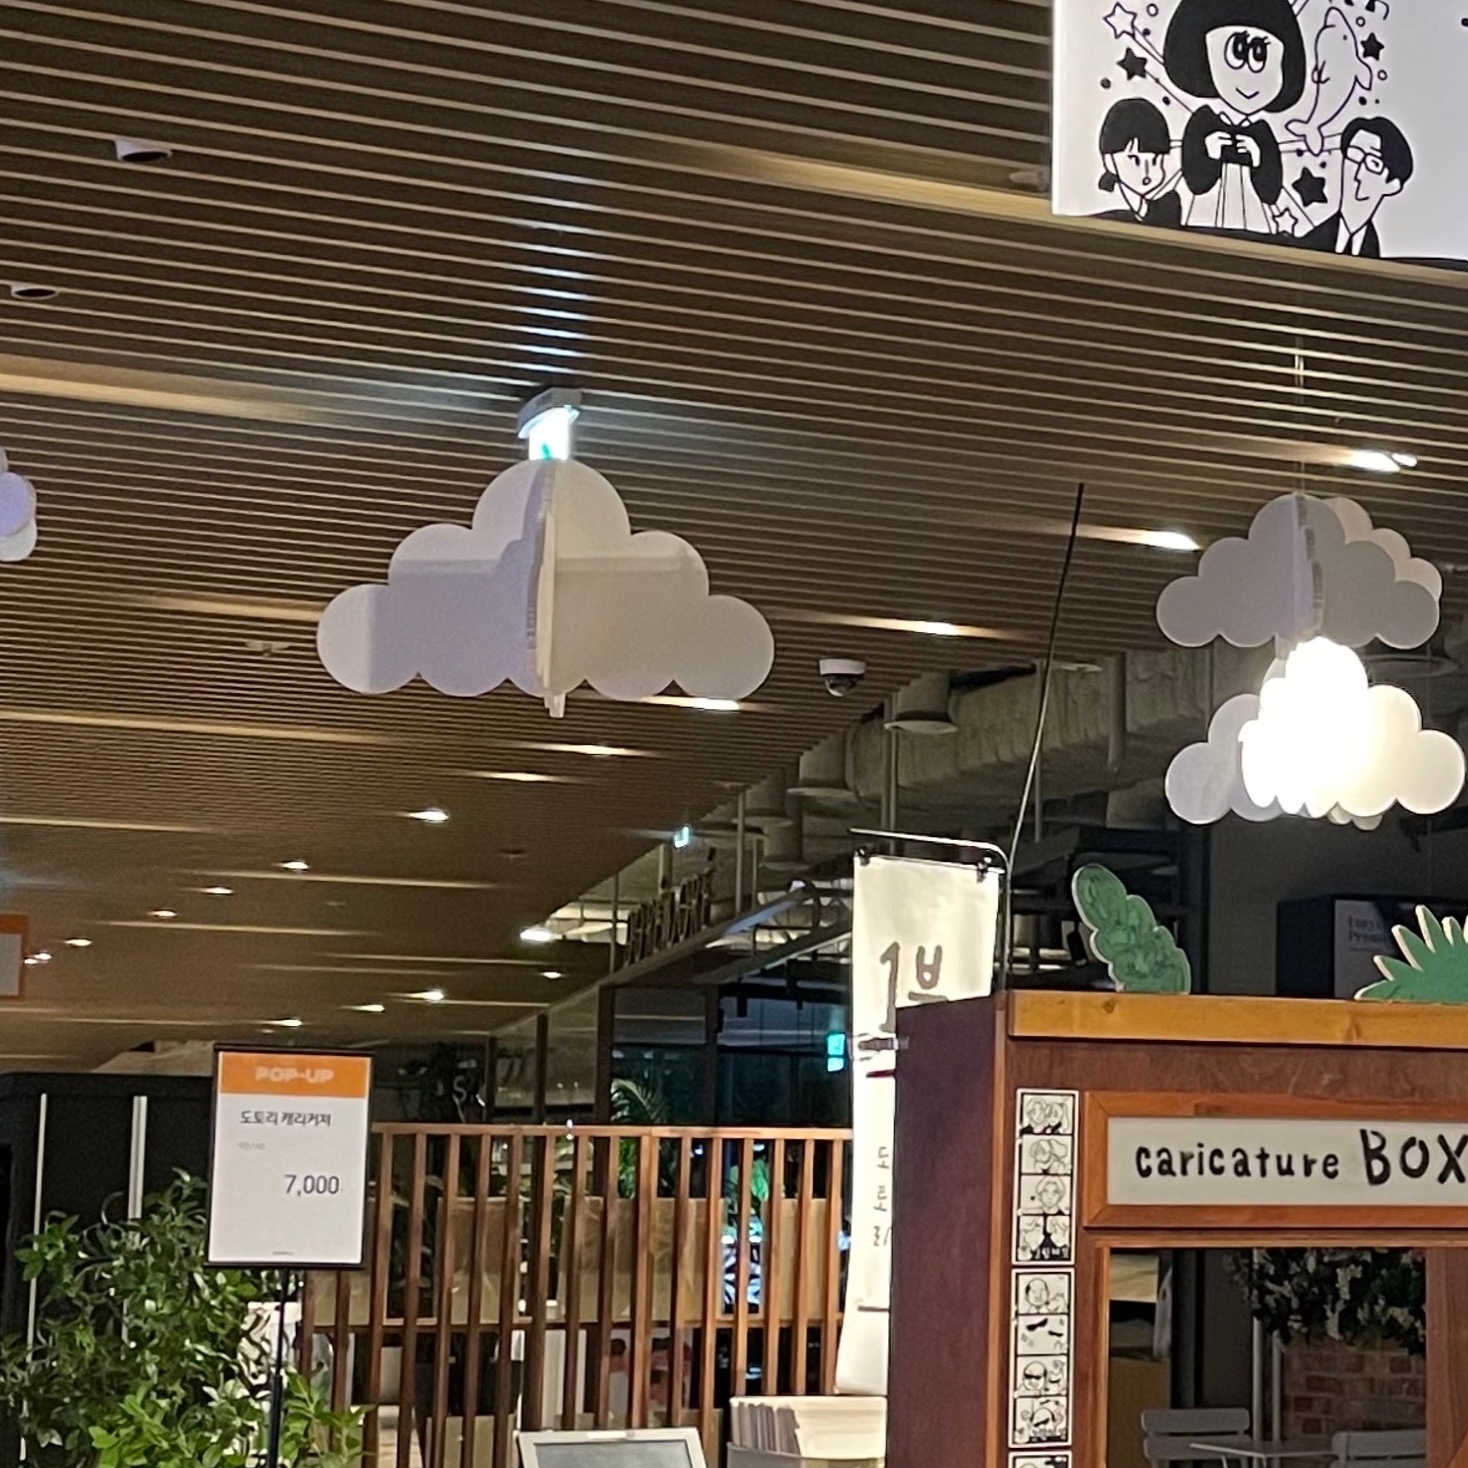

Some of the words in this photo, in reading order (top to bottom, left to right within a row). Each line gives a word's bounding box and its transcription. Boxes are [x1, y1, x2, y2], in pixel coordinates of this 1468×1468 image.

[255, 1066, 335, 1084] POP-UP
[240, 1110, 278, 1127] 도토리
[1134, 1141, 1340, 1180] caricature
[284, 1173, 341, 1197] 7,000
